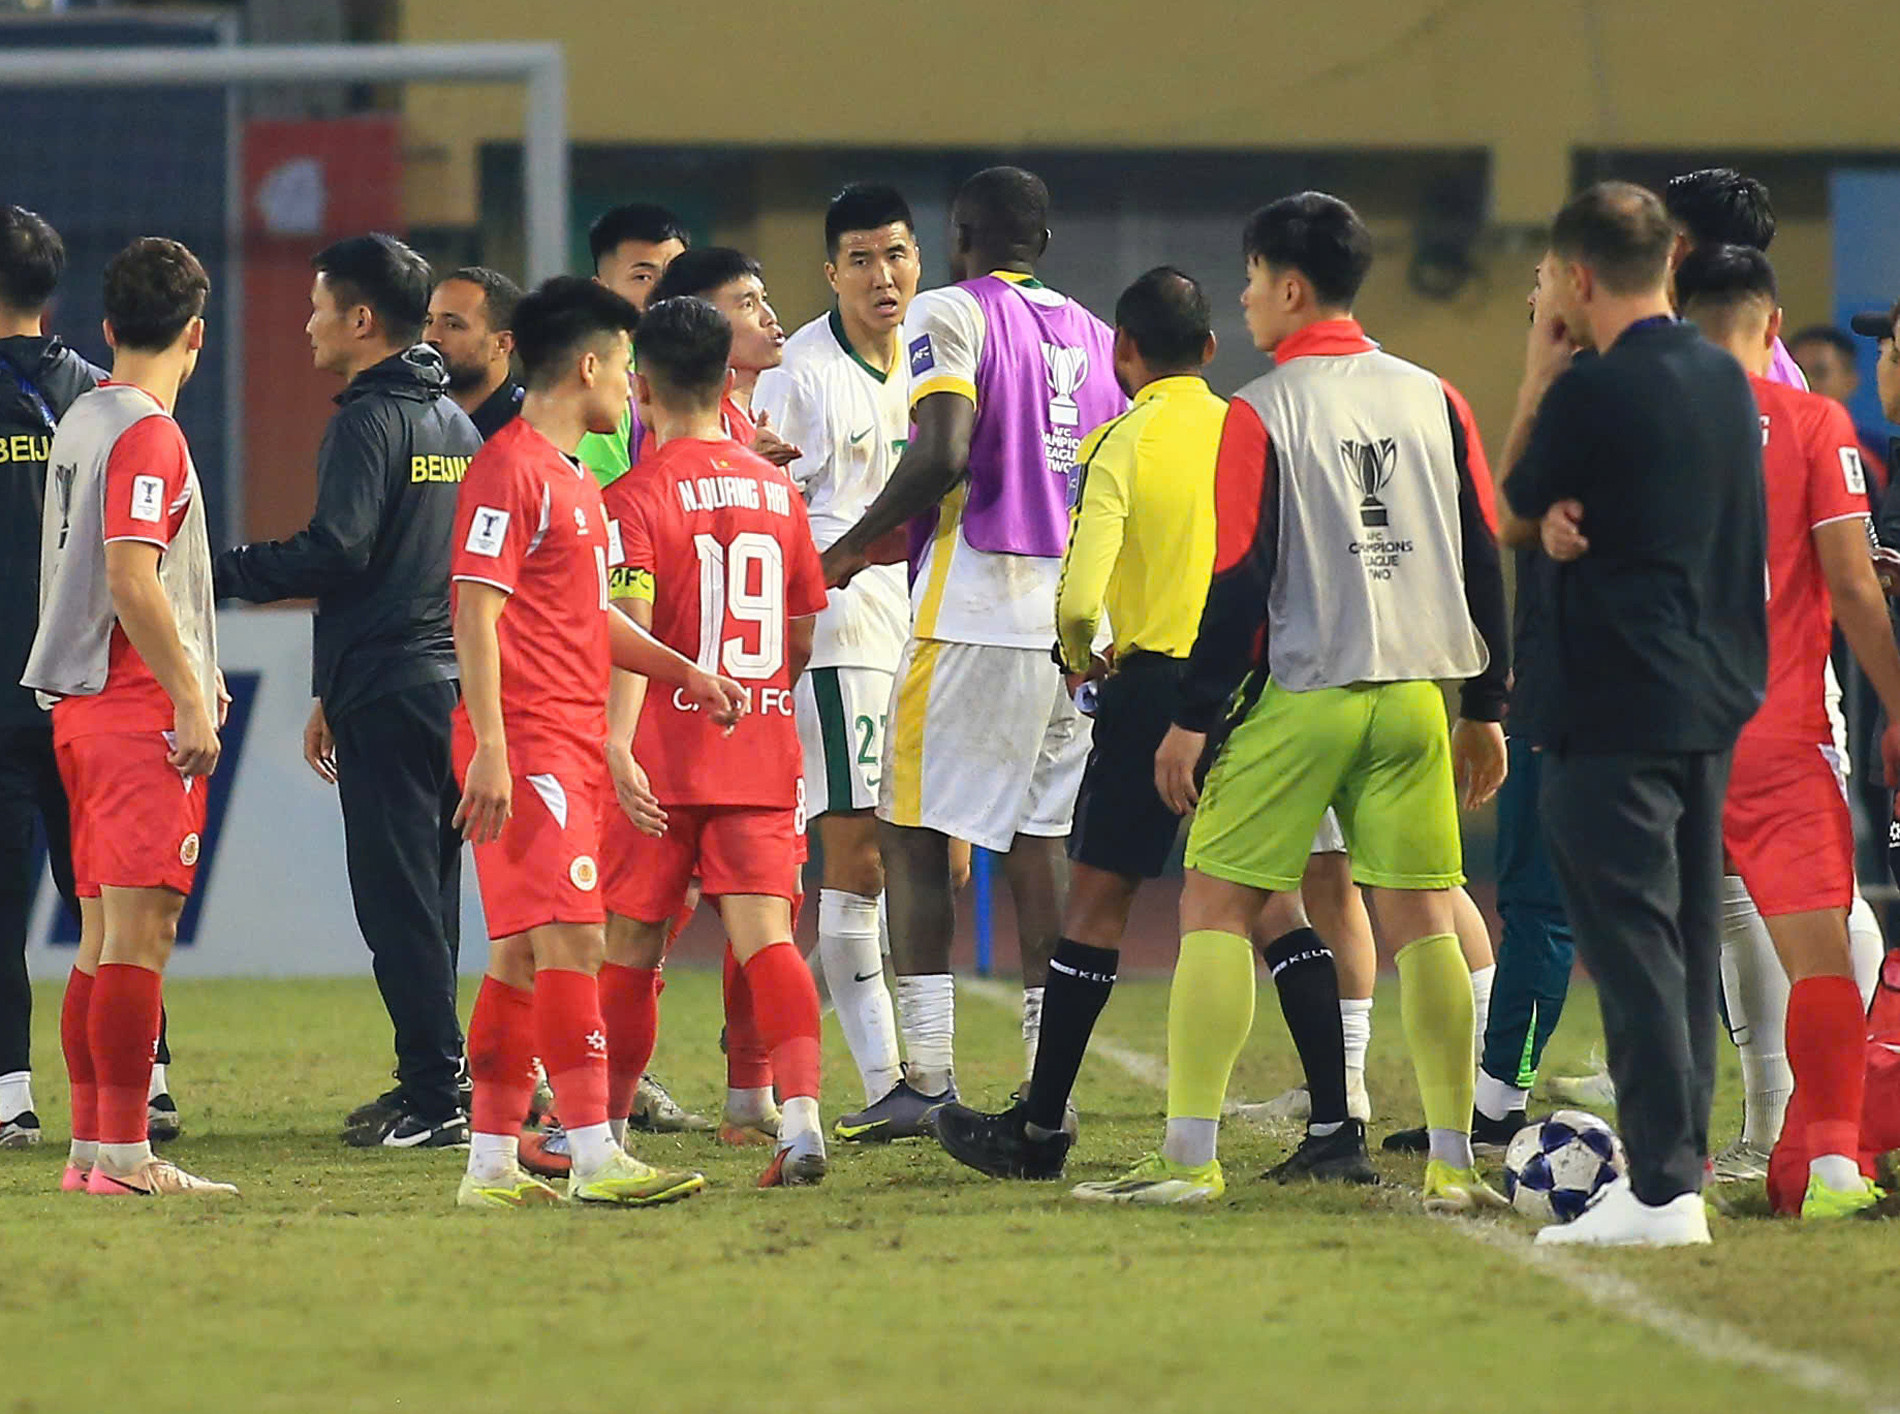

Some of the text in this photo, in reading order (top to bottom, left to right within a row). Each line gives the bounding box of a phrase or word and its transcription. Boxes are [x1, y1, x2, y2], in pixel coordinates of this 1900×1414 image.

[1040, 429, 1084, 450] AMPIO
[1053, 426, 1072, 437] AFC
[1045, 446, 1077, 462] EAGU
[677, 476, 760, 512] N.QUANG
[1364, 555, 1399, 567] AGUE
[693, 532, 784, 680] 19
[760, 687, 792, 716] FC
[855, 714, 888, 765] 2
[1078, 969, 1117, 983] KEL
